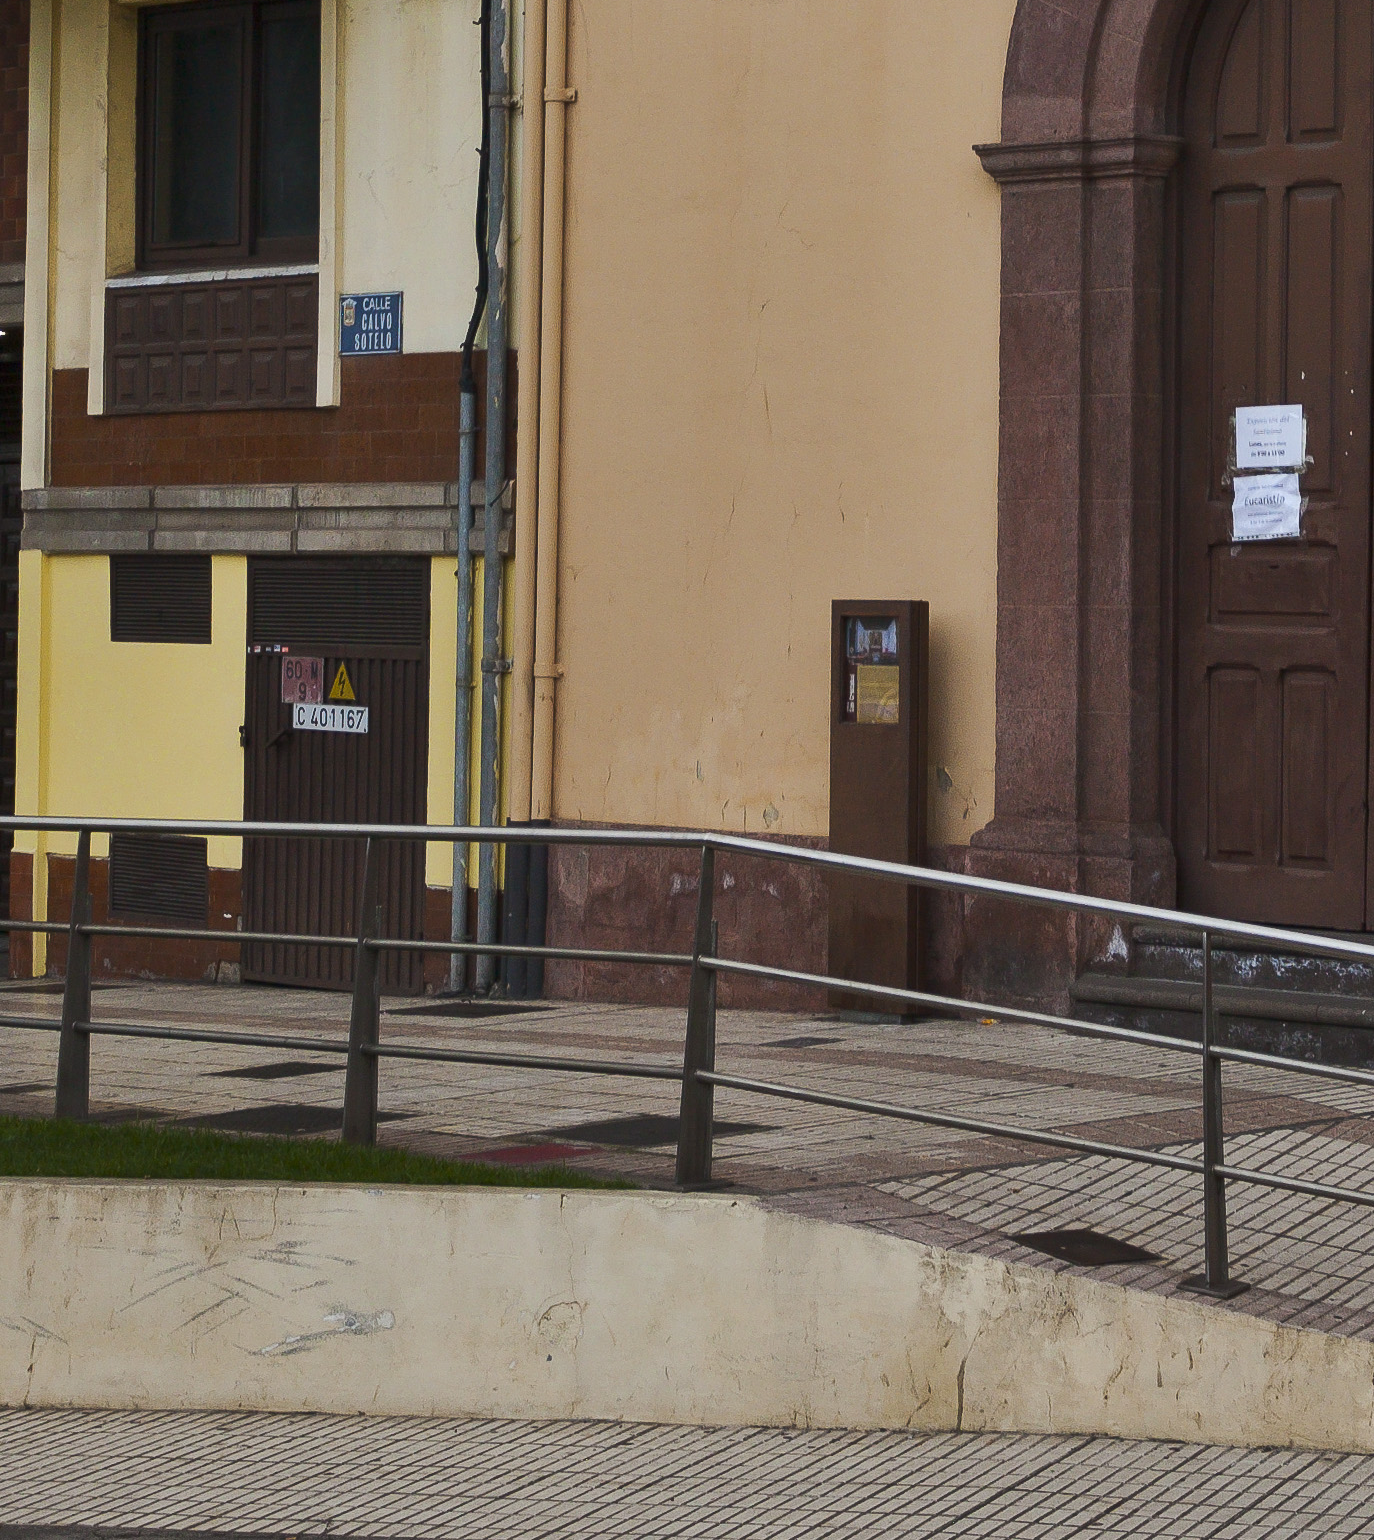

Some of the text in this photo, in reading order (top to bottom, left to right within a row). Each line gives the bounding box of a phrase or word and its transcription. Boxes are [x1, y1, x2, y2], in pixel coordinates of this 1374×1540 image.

[363, 297, 390, 311] CALLE
[362, 313, 391, 330] CALVO
[355, 332, 391, 350] SOTELO
[299, 682, 307, 701] 9
[298, 707, 364, 729] C 401167
